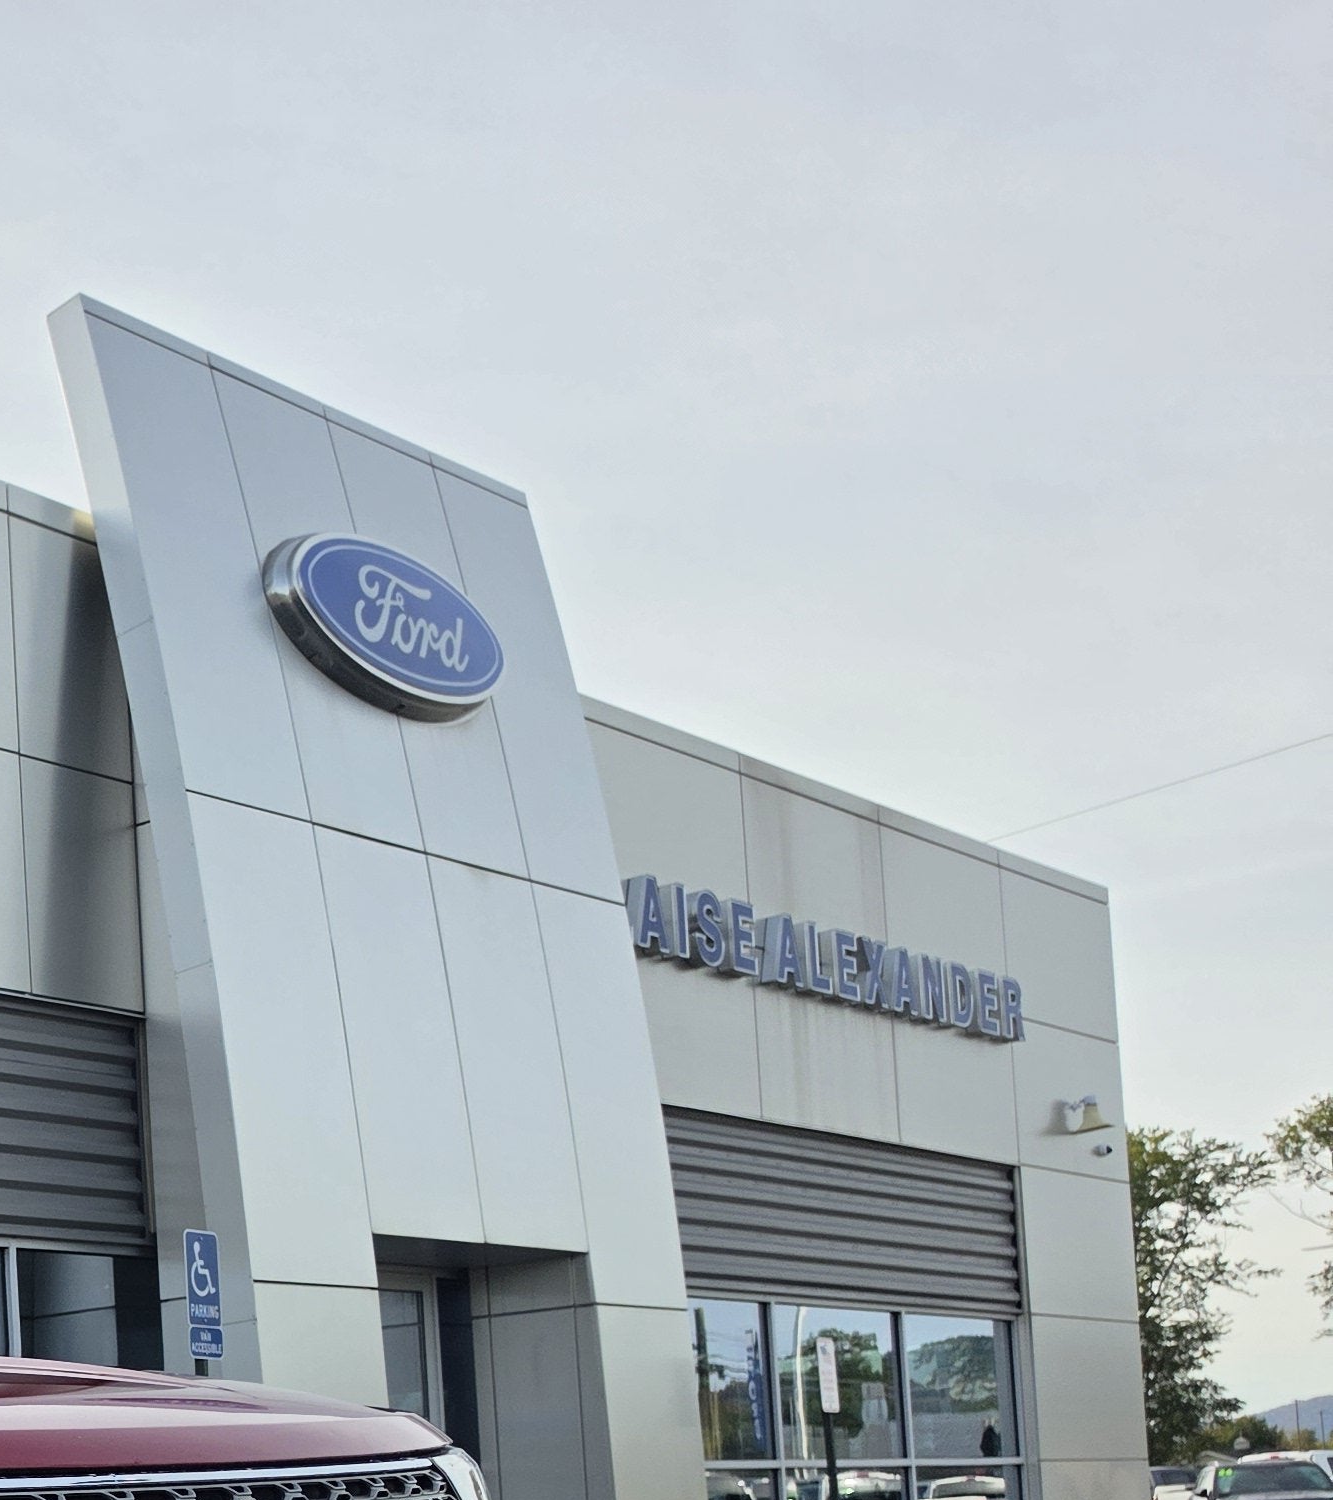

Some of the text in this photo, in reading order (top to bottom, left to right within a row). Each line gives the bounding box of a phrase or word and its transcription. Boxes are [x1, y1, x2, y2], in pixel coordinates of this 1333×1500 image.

[354, 564, 469, 673] Ford
[763, 913, 1025, 1042] ALEXANDER
[190, 1304, 220, 1320] PARKING
[200, 1331, 212, 1341] VAN
[192, 1342, 223, 1355] ACCESSIBLE
